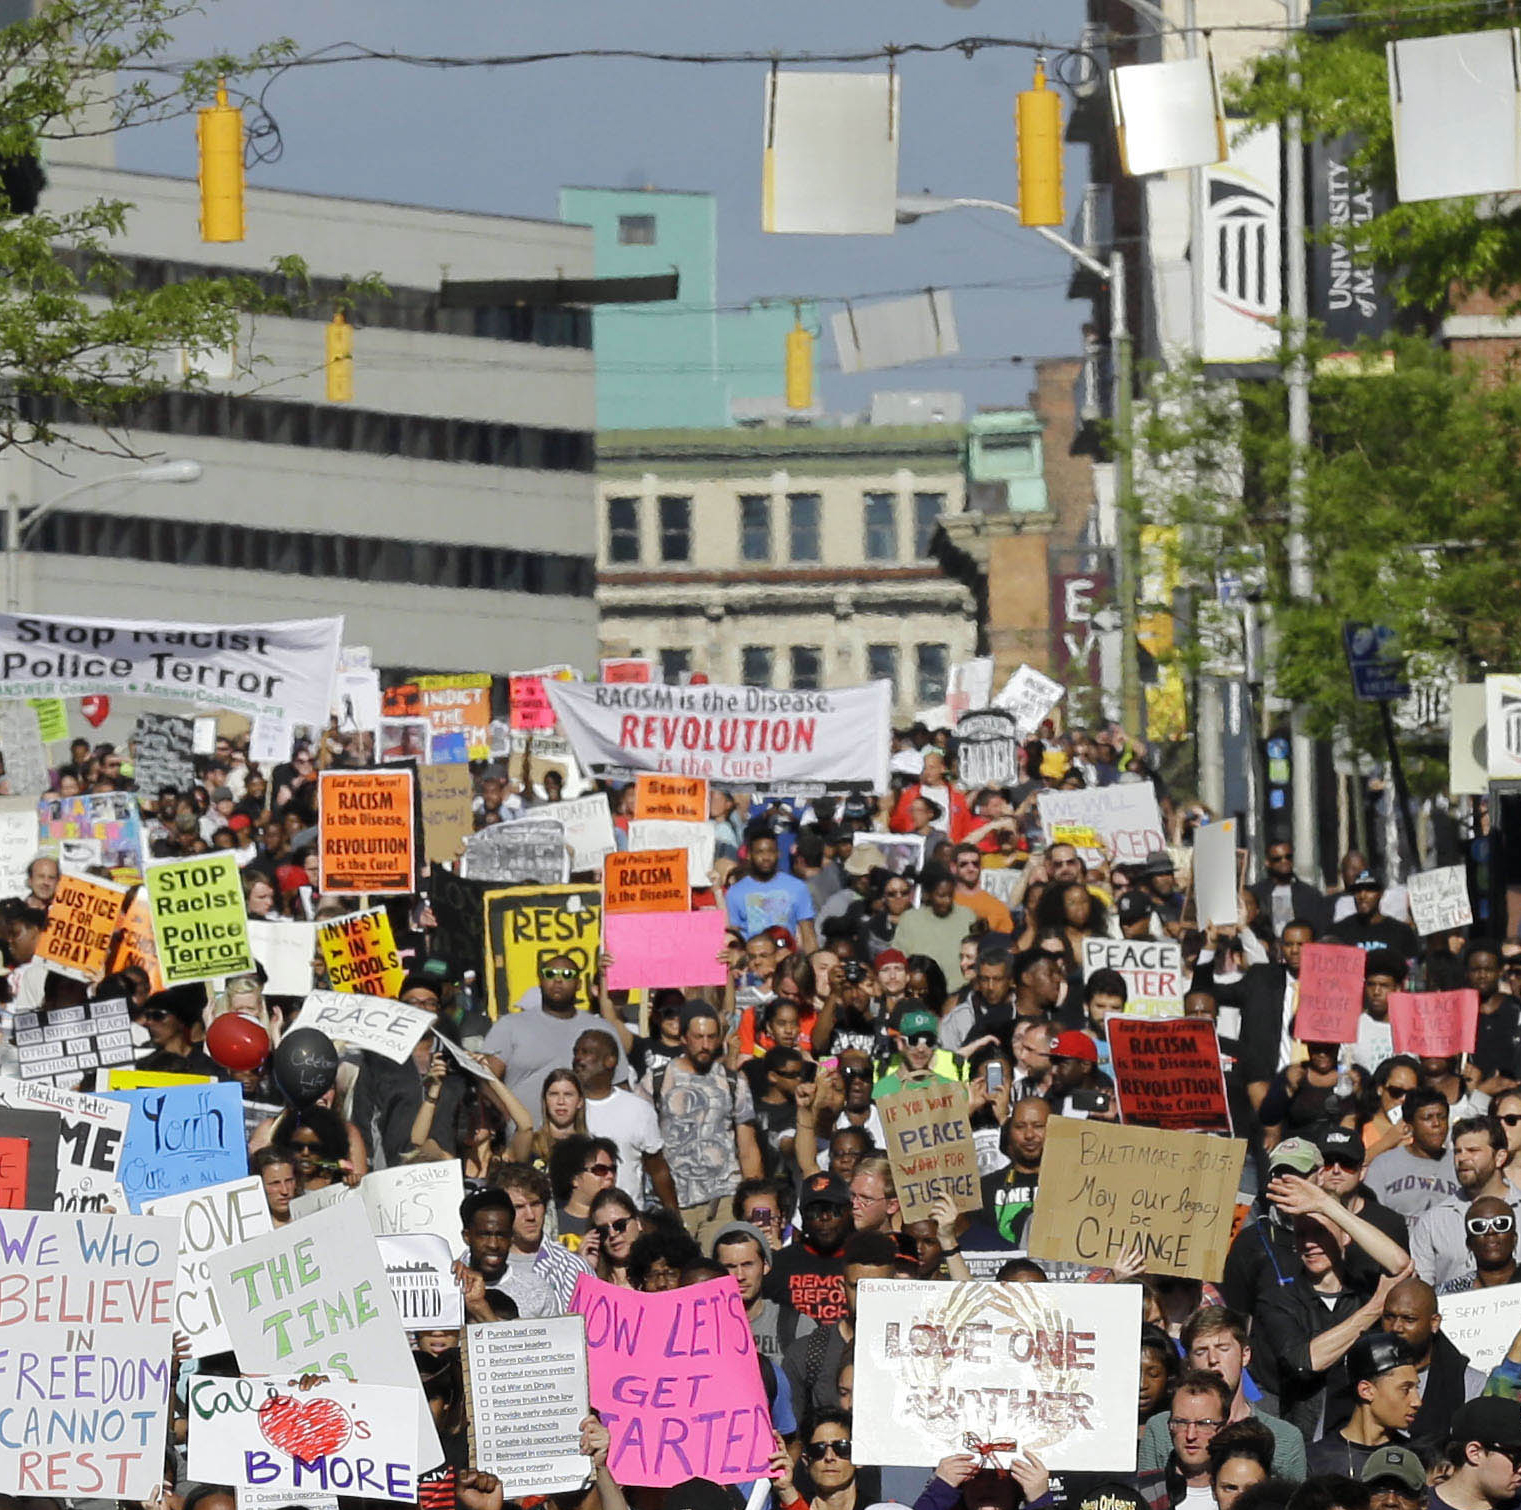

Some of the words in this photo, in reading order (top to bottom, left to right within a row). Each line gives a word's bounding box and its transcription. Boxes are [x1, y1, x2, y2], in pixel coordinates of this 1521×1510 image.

[1328, 159, 1352, 309] UNIVRSITY
[16, 619, 116, 648] Stop
[2, 652, 134, 679] Police
[150, 652, 284, 699] Terror
[595, 687, 673, 711] RACISM
[701, 687, 738, 712] the
[619, 714, 816, 753] REVOLUTION
[721, 754, 775, 779] Cure!
[338, 792, 393, 810] RACISM
[647, 781, 698, 796] Stand
[326, 838, 408, 855] REVOLUTION
[159, 864, 226, 893] STOP
[619, 868, 673, 886] RACISM
[55, 887, 118, 919] JUSTICE
[157, 888, 240, 917] Racist
[48, 917, 110, 950] FREDDIE
[163, 921, 244, 946] Police
[323, 911, 383, 942] INVEST
[48, 937, 92, 964] GRAY
[164, 940, 246, 965] Terror
[348, 937, 367, 956] IN
[1086, 941, 1178, 970] PEACE
[330, 951, 400, 985] SCHOOLS
[45, 1022, 95, 1039] SUPPORT
[315, 1006, 417, 1037] RACE
[21, 1046, 59, 1060] OTHER
[1129, 1036, 1197, 1054] RACISM
[24, 1060, 76, 1076] NOTHING
[1120, 1078, 1221, 1097] REVOLUTION
[926, 1094, 955, 1112] WANT
[142, 1091, 225, 1155] Youth
[898, 1120, 967, 1153] PEACE
[899, 1155, 942, 1177] WORK
[944, 1152, 966, 1168] FOR
[902, 1174, 974, 1208] JUSTICE
[1073, 1175, 1117, 1217] May
[1131, 1188, 1172, 1211] our
[1177, 1188, 1221, 1230] legacy
[1129, 1210, 1152, 1227] be
[78, 1217, 160, 1267] WHO
[1075, 1216, 1192, 1268] CHANGE
[230, 1237, 321, 1313] THE
[262, 1279, 381, 1361] TIME
[576, 1288, 645, 1357] NOW
[664, 1288, 750, 1359] LET'S
[1454, 1305, 1488, 1319] SENT
[66, 1330, 94, 1353] IN
[884, 1321, 993, 1365] LOVE
[1008, 1328, 1096, 1371] ONE
[611, 1374, 714, 1409] GET
[18, 1451, 143, 1495] REST
